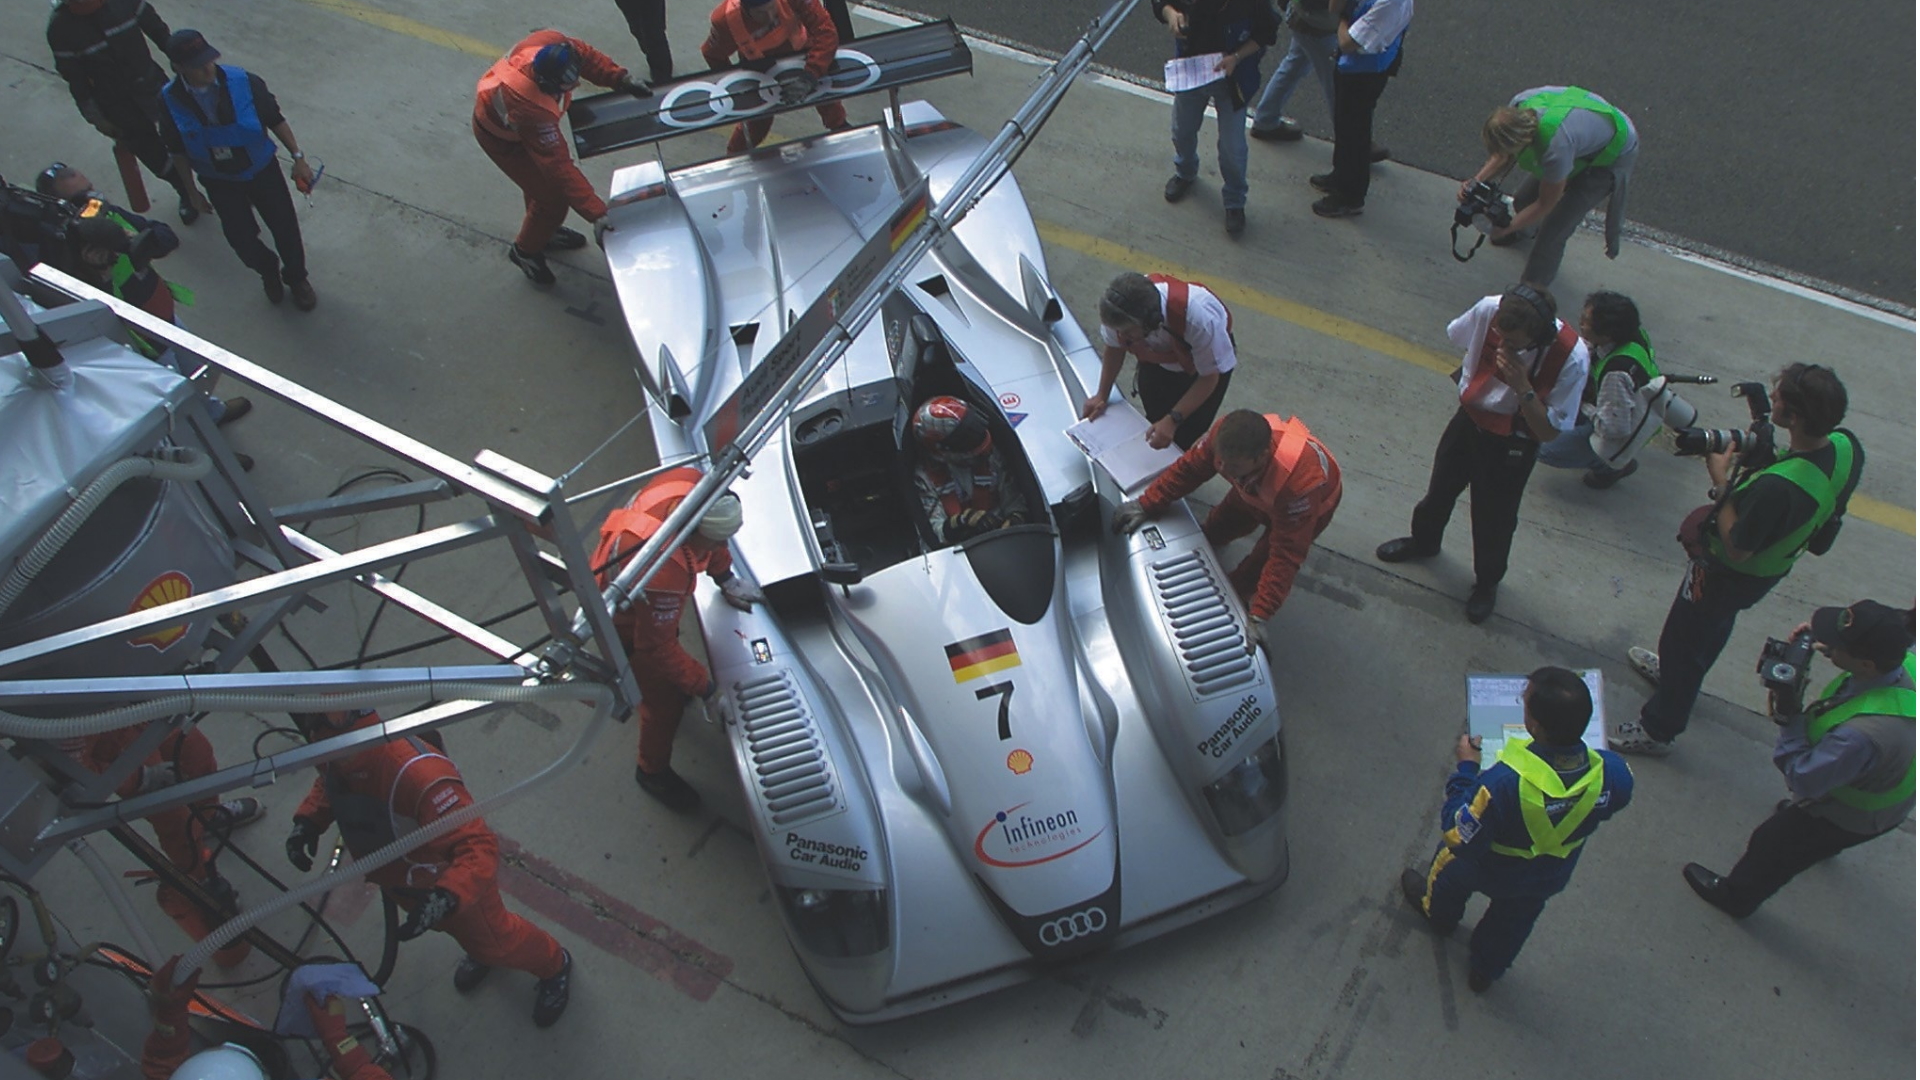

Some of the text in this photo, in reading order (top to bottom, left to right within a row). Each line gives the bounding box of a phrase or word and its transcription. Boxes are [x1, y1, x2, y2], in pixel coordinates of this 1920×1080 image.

[974, 680, 1014, 741] 7
[1197, 694, 1257, 756] Panasonic
[1212, 707, 1262, 758] Car Audio
[1002, 809, 1078, 845] Infineon
[1009, 826, 1082, 853] technologies
[786, 832, 868, 860] Panasonic
[790, 848, 861, 872] Car Audio
